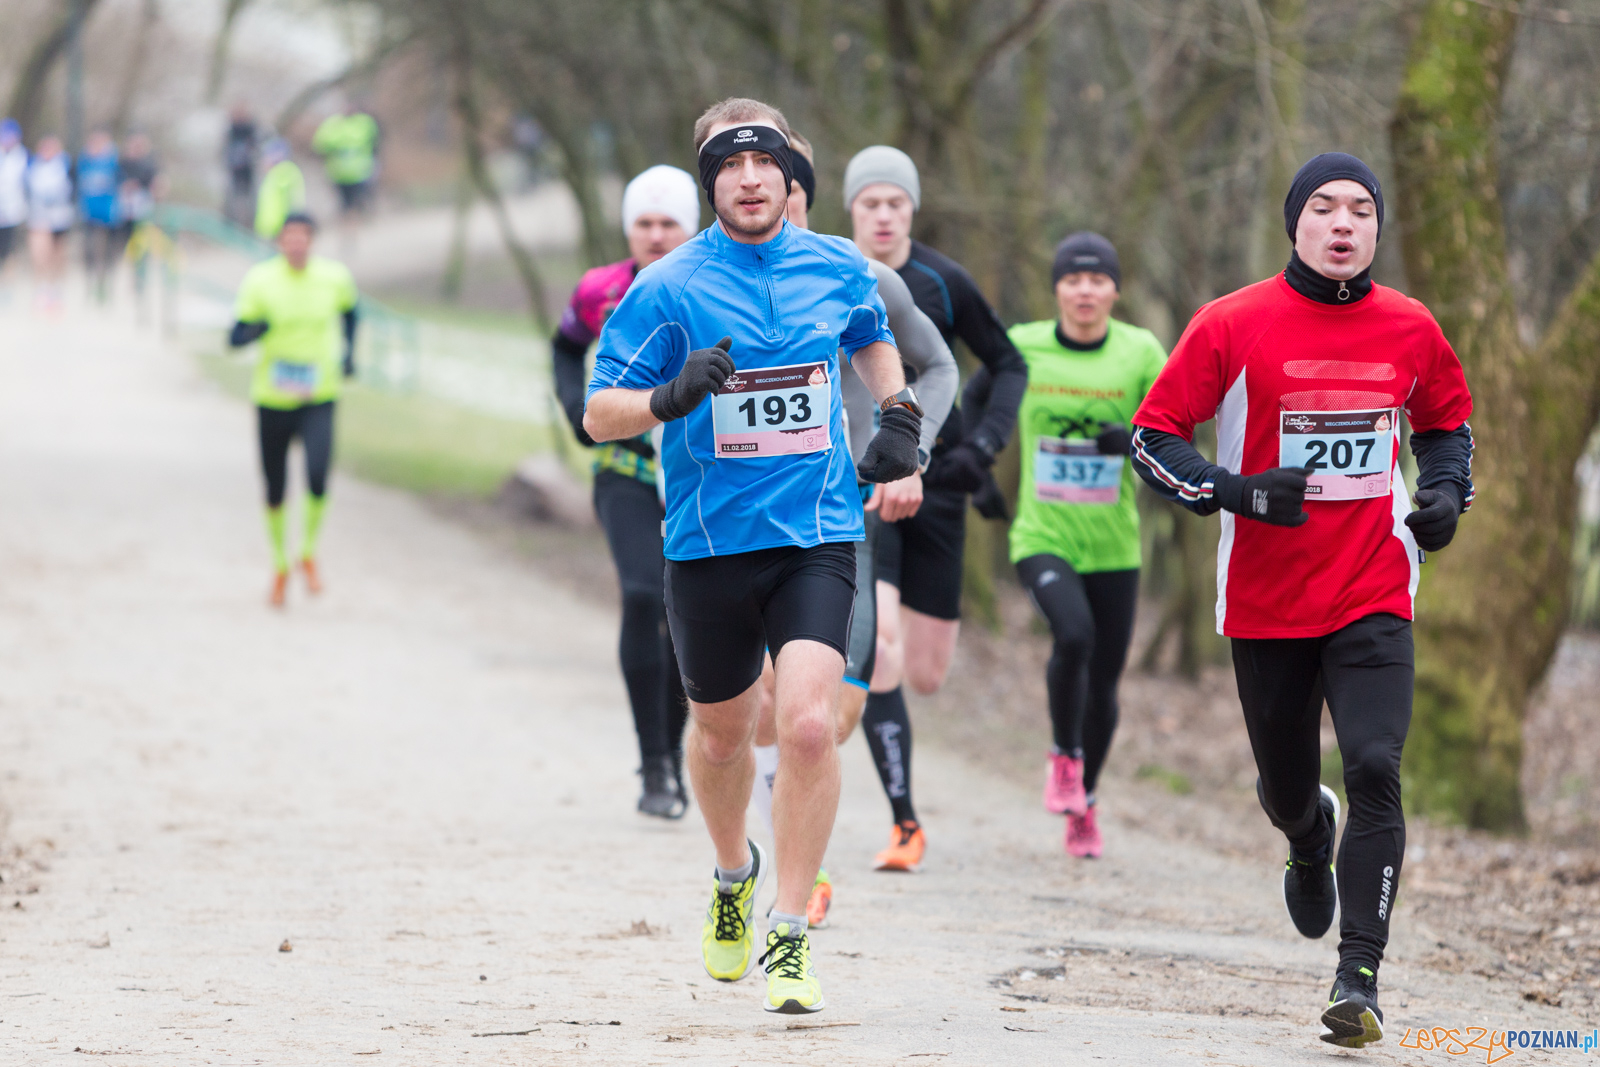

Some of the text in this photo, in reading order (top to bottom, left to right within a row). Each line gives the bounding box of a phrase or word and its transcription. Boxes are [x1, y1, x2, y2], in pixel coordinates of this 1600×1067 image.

[738, 392, 812, 427] 193
[722, 444, 757, 452] 11.02.2018
[1303, 438, 1376, 470] 207
[1051, 459, 1105, 482] 337
[1378, 877, 1392, 921] HI-TEC
